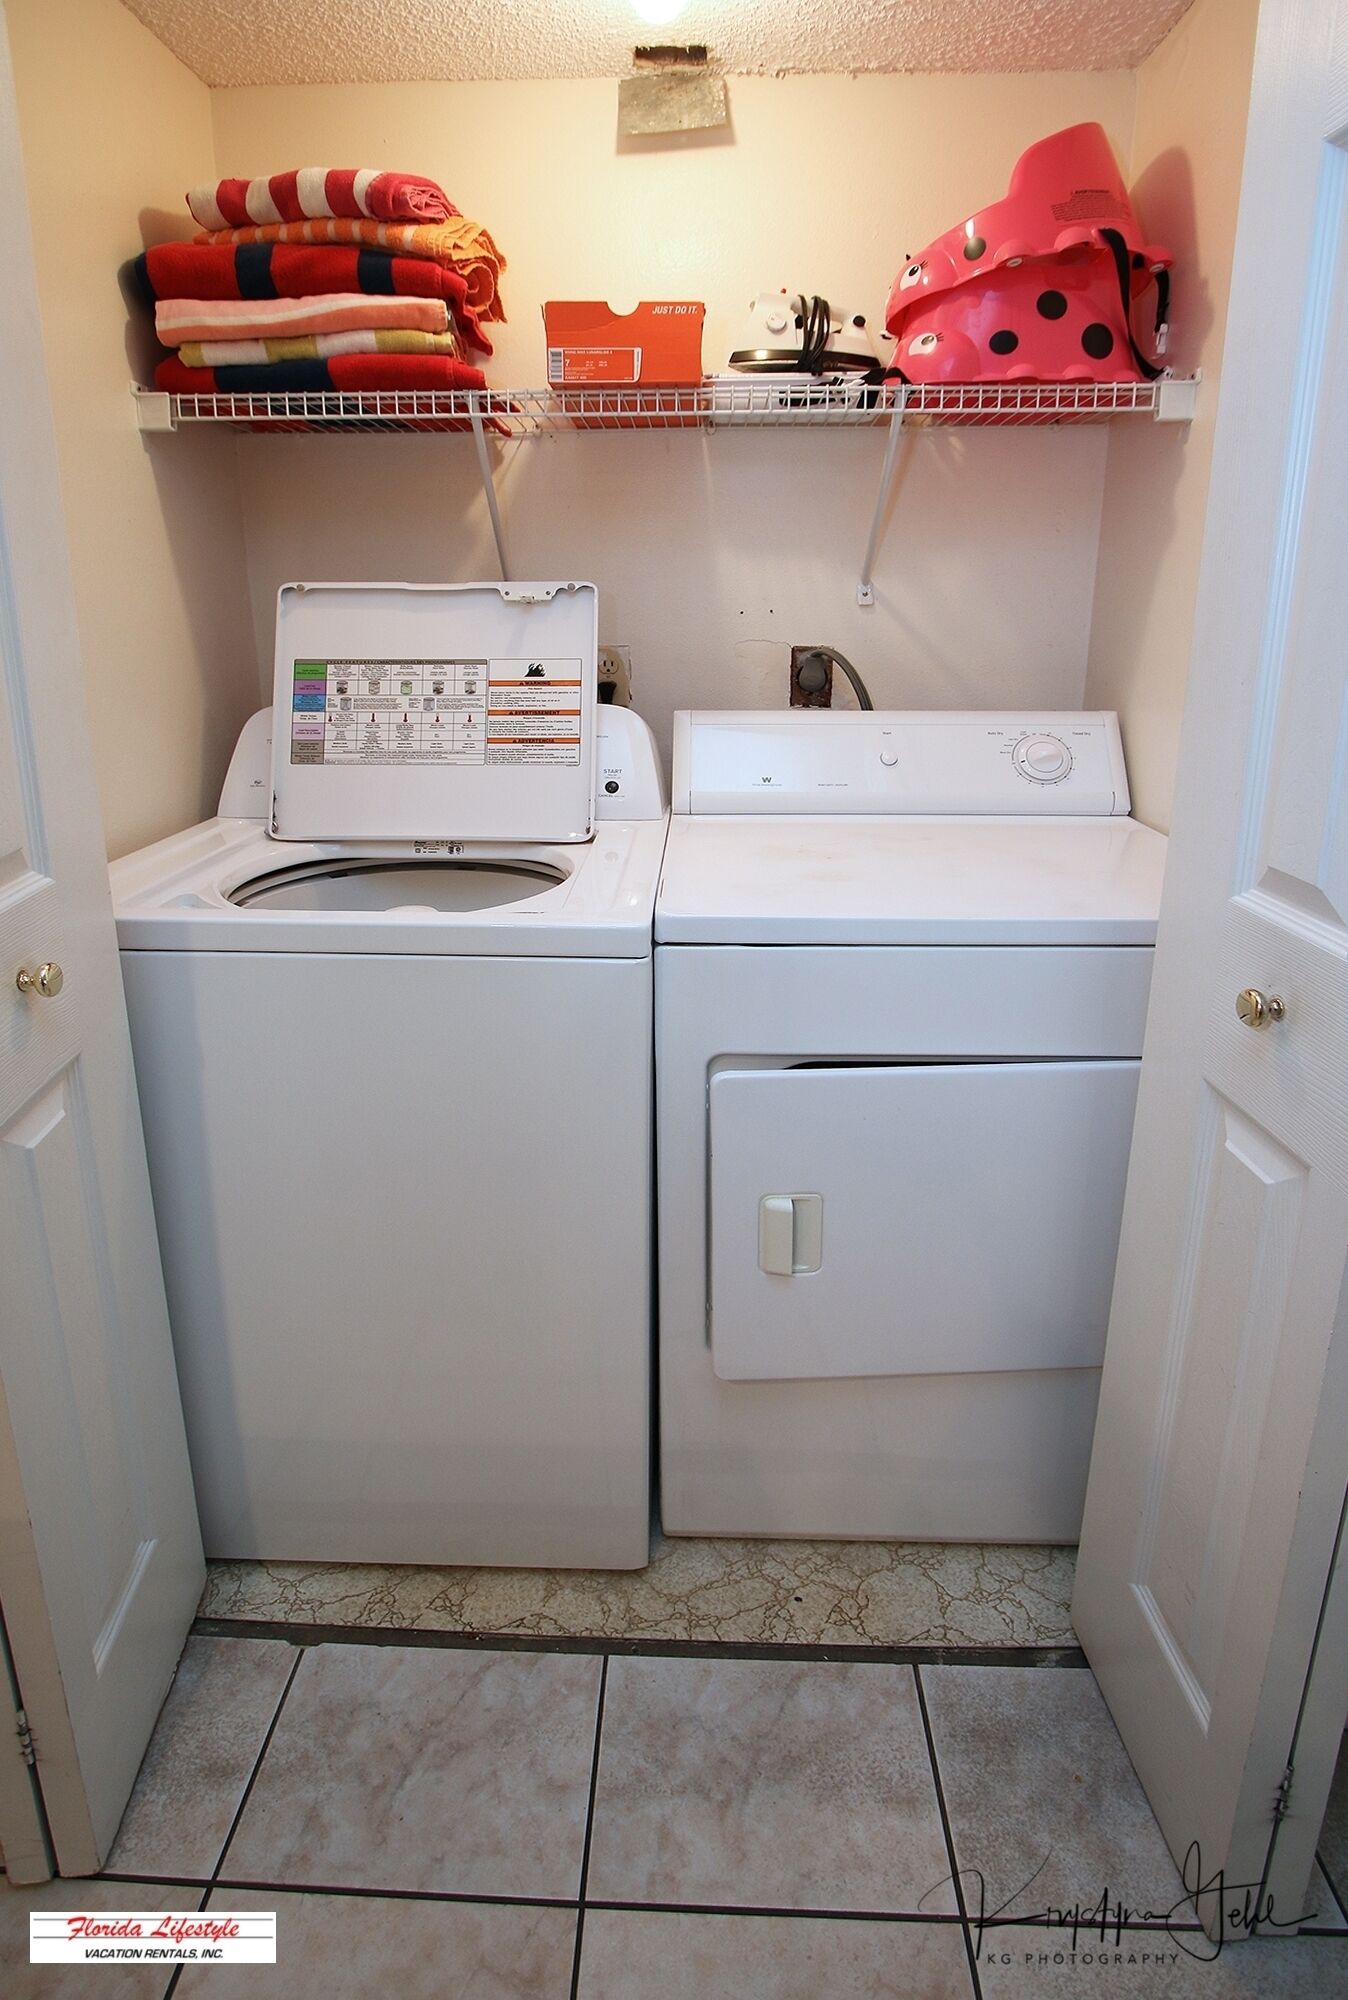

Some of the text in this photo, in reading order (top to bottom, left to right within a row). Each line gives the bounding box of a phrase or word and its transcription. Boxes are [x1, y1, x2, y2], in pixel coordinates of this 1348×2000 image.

[652, 305, 673, 314] JUST
[675, 305, 687, 314] DO
[564, 359, 571, 367] 7
